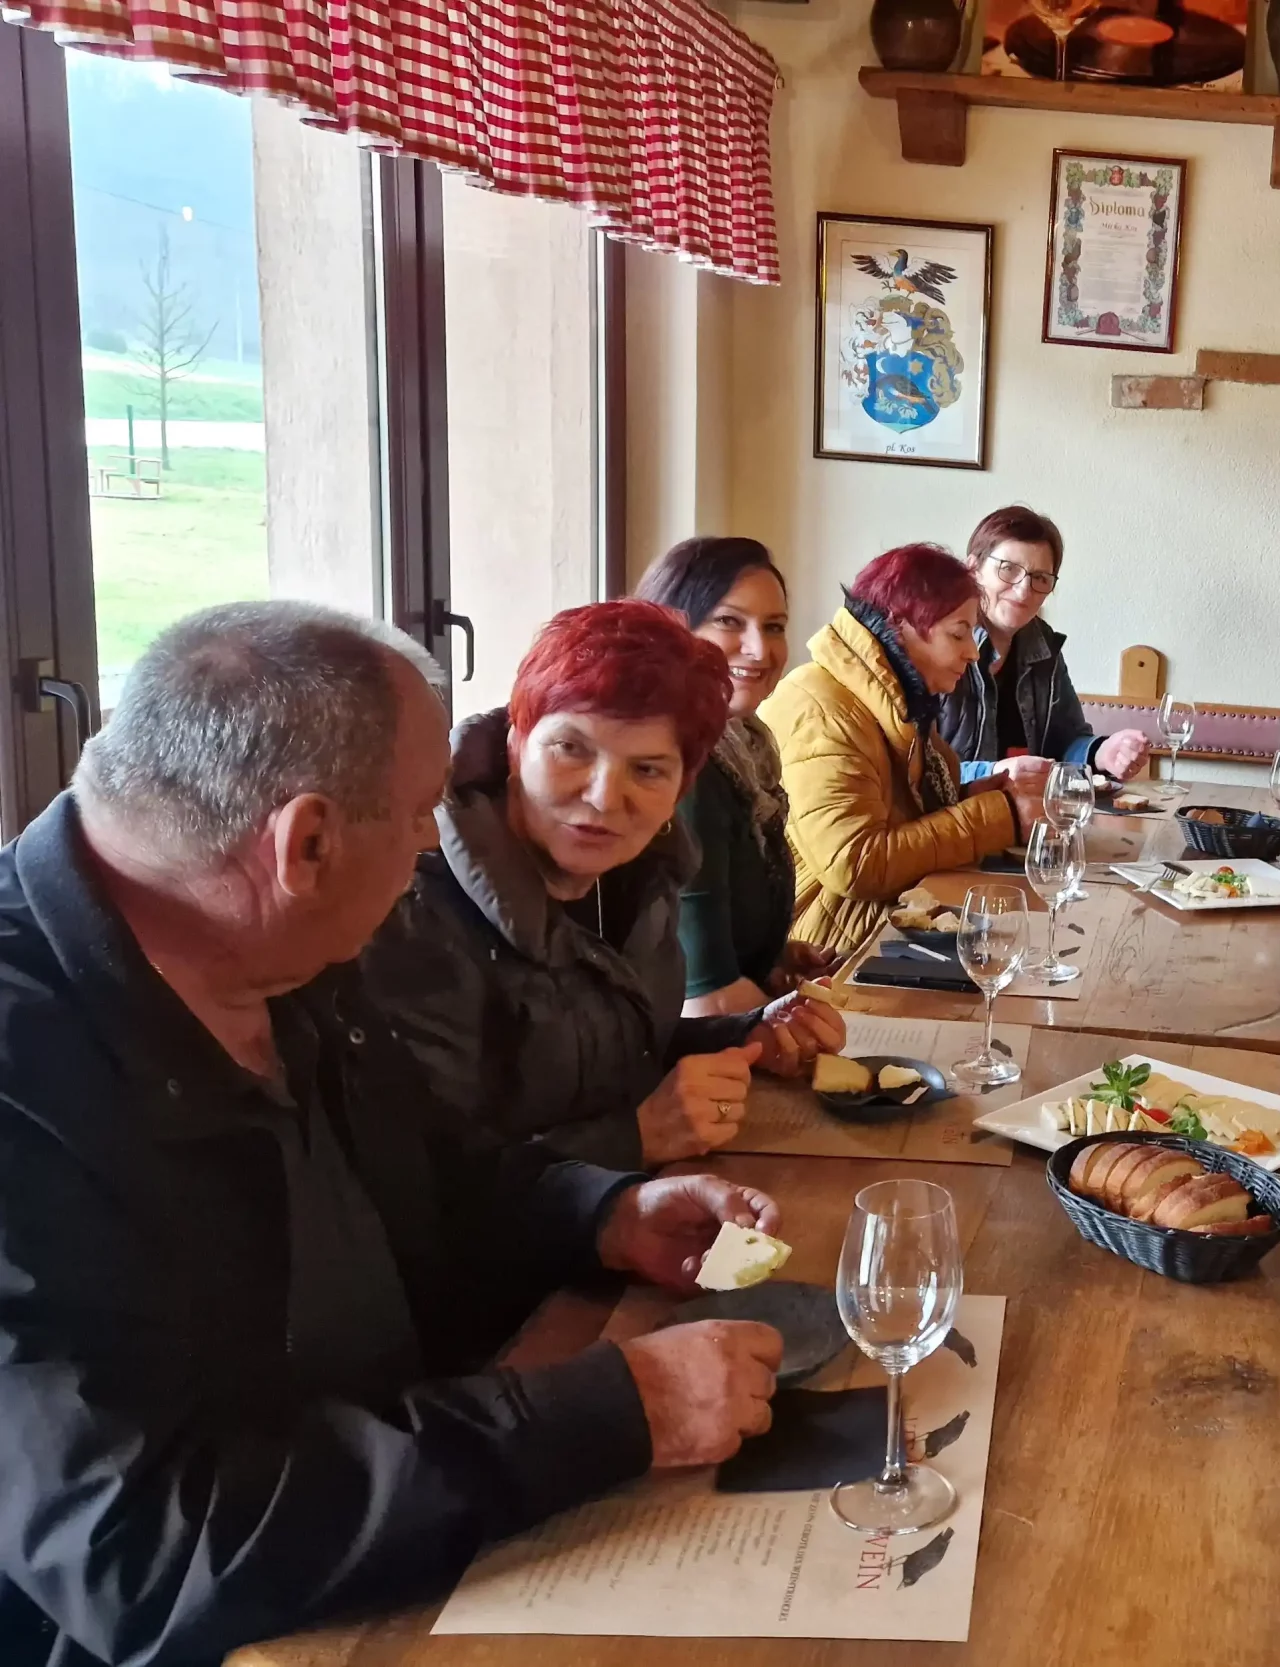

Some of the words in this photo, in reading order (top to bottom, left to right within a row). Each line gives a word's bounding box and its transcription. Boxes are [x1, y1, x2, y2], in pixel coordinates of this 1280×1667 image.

[1089, 196, 1145, 217] Diploma
[899, 444, 915, 454] Kos
[855, 1526, 890, 1590] WEIN
